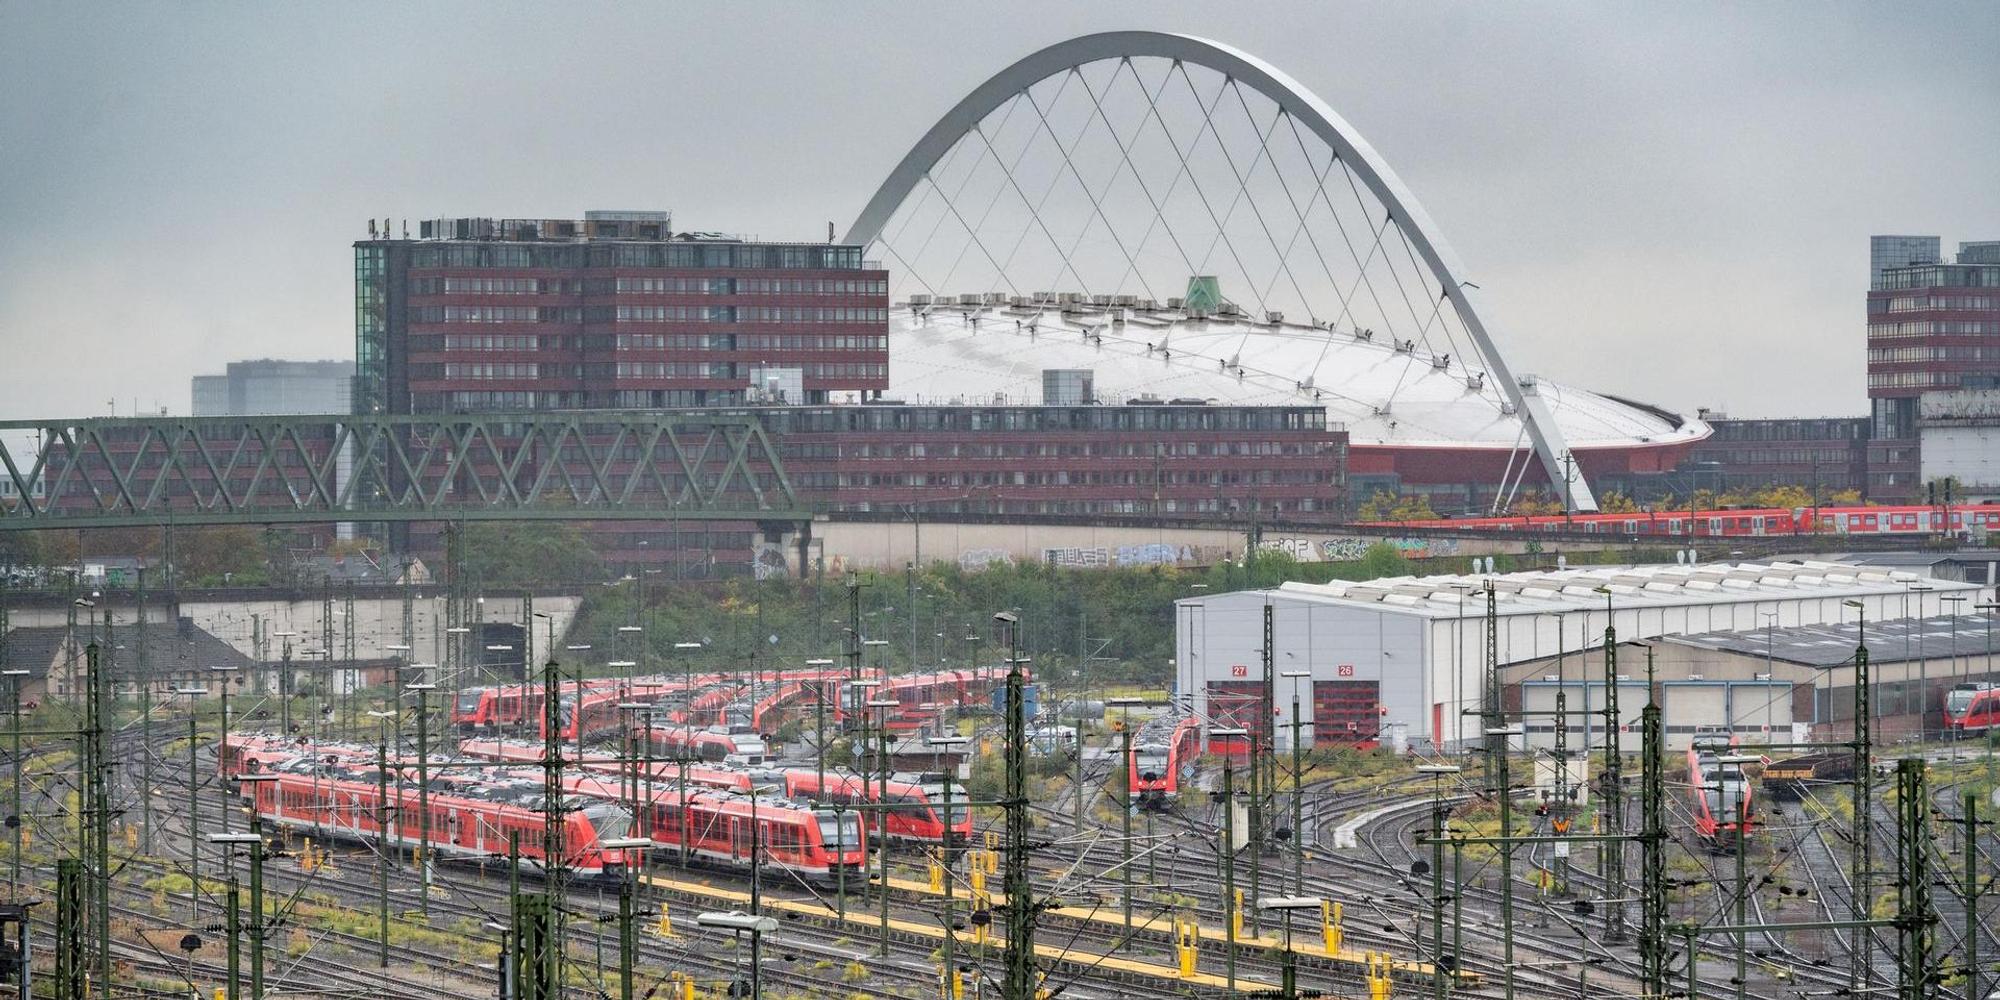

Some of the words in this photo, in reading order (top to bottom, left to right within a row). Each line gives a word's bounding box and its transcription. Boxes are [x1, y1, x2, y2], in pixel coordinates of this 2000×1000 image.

[1233, 666, 1245, 675] 27
[1340, 666, 1352, 675] 26
[1552, 816, 1571, 832] W
